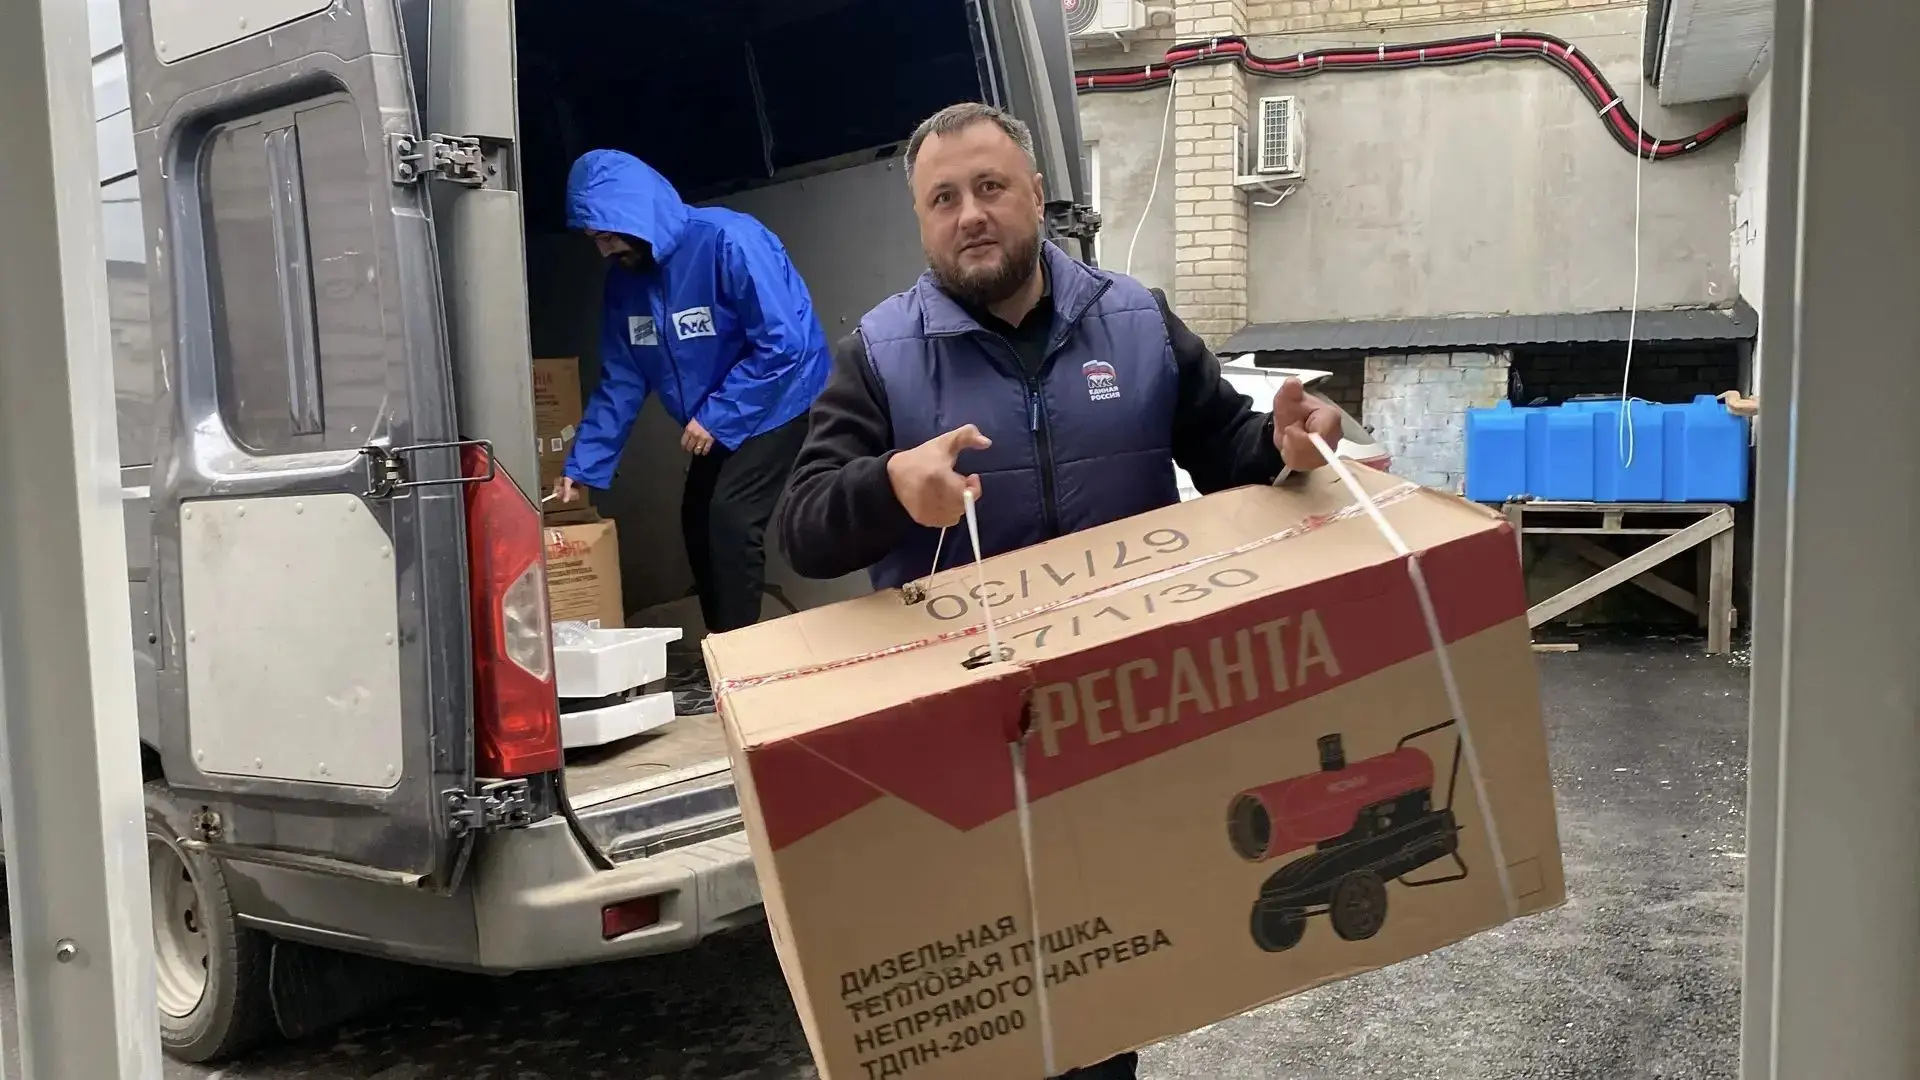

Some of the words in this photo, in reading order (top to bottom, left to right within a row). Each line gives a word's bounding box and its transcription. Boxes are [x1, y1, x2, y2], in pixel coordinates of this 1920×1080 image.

[1089, 386, 1118, 395] ЕДИННАЯ
[1091, 392, 1120, 401] РОССИЯ
[1035, 608, 1343, 757] РЕСАНТА
[840, 915, 1017, 999] ДИЗЕЛЬНАЯ
[845, 952, 1004, 1023] ТЕПЛОВАЯ
[853, 975, 1034, 1054] НЕПРЯМОГО
[1043, 929, 1172, 989] НАГРЕВА
[860, 1009, 1026, 1080] ТДПН-20000
